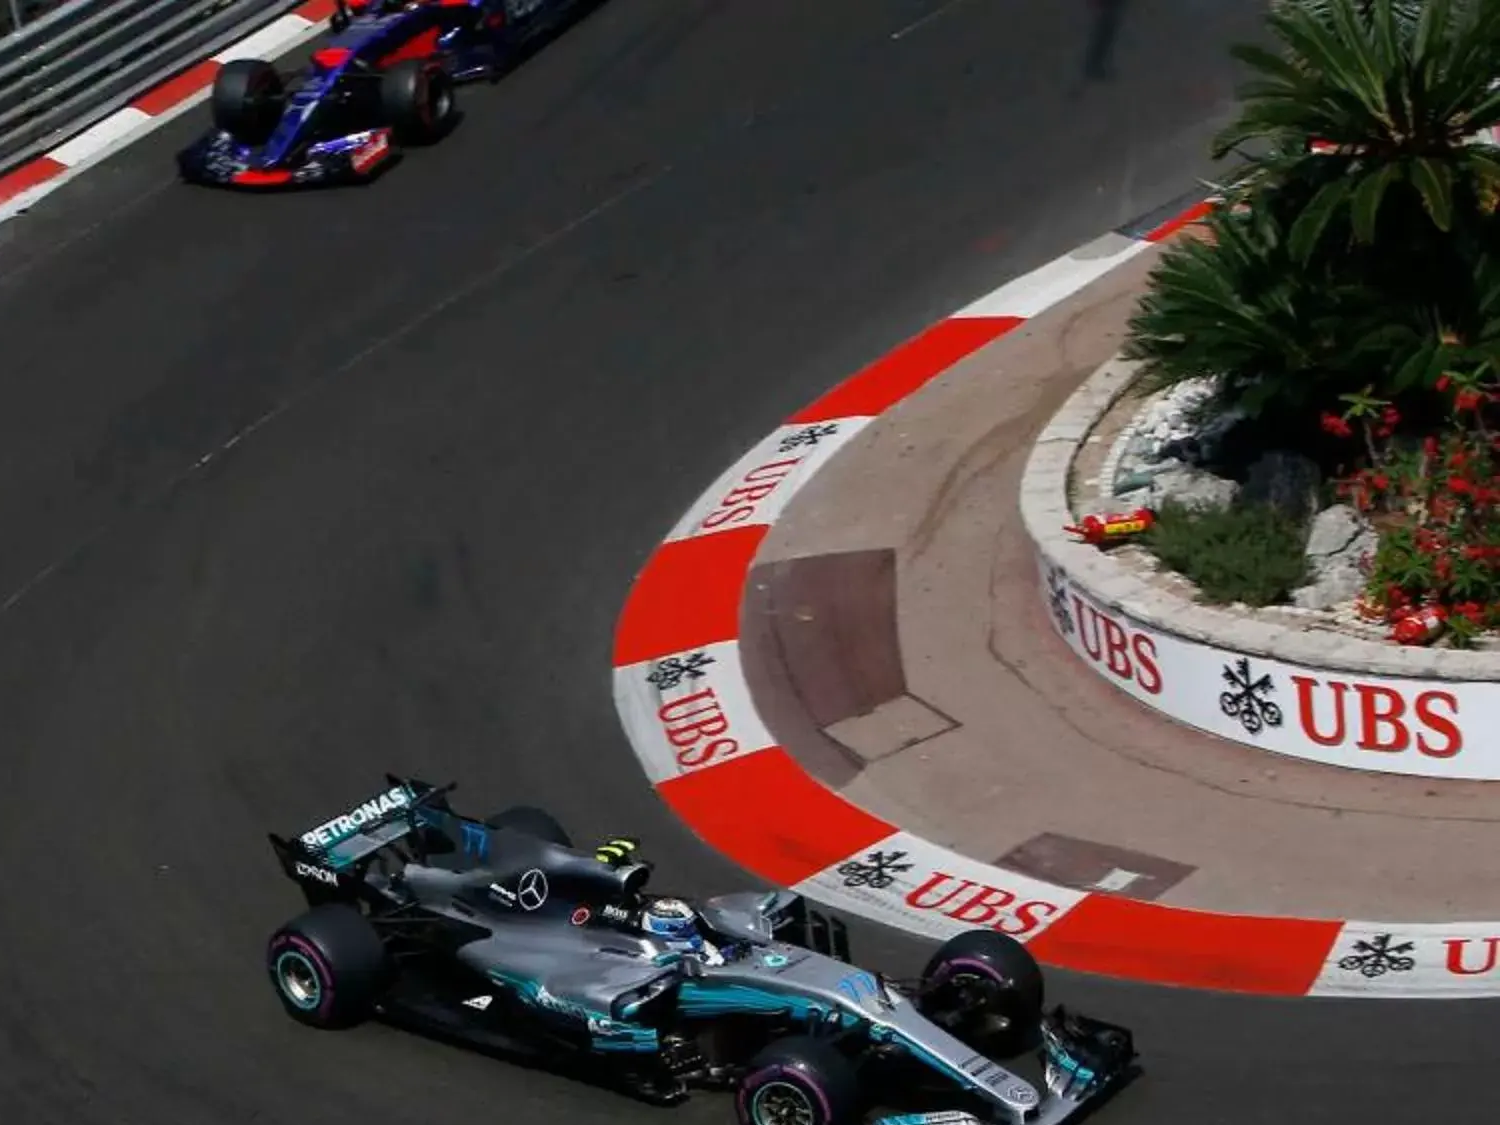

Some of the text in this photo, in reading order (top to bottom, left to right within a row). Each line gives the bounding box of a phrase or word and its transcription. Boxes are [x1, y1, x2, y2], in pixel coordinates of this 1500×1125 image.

[702, 456, 804, 528] UBS
[1072, 595, 1162, 695] UBS
[658, 687, 739, 767] UBS
[1290, 674, 1464, 759] UBS
[300, 784, 409, 846] PETRONAS
[904, 871, 1058, 935] UBS
